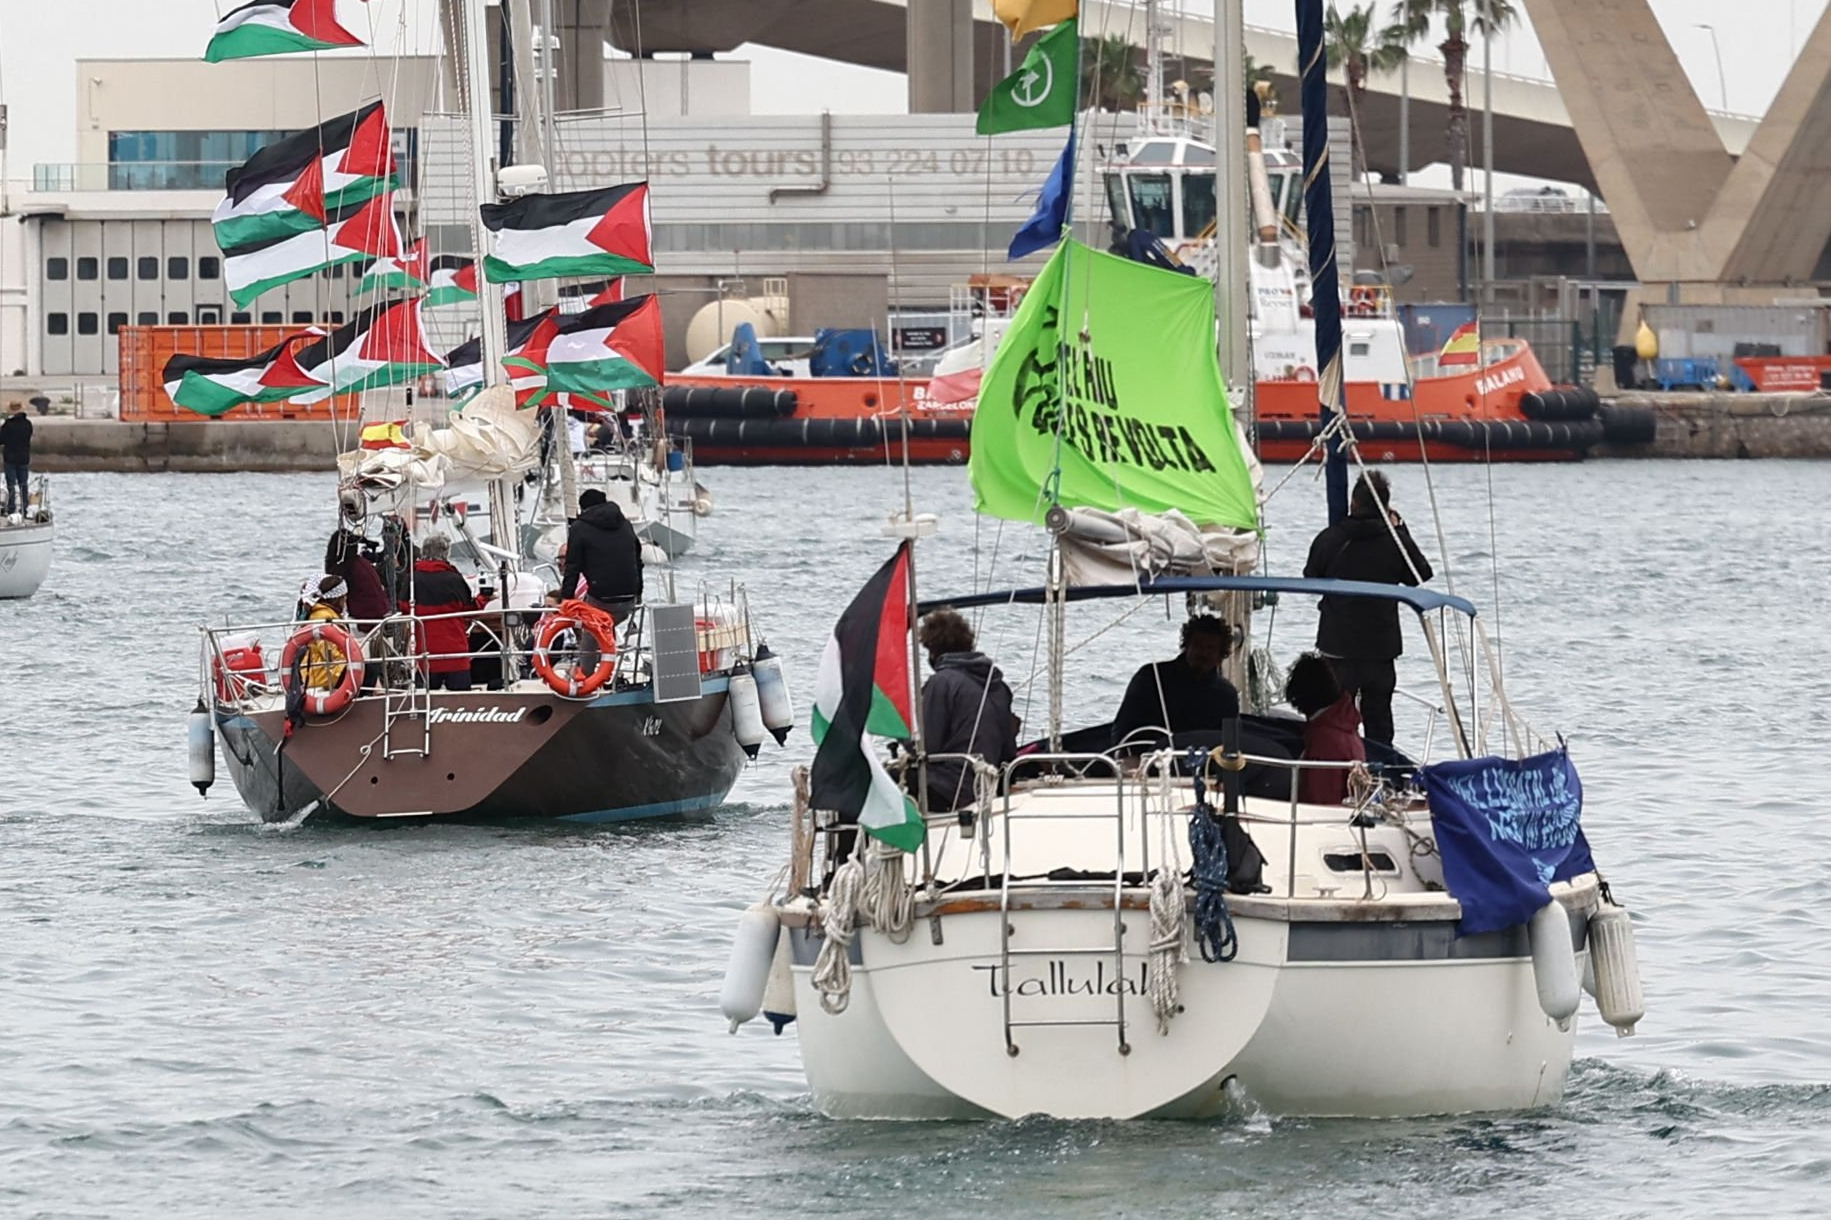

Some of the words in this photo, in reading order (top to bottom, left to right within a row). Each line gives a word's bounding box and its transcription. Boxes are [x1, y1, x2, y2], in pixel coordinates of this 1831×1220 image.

[705, 143, 817, 177] tours
[838, 149, 875, 176] 93
[885, 149, 939, 175] 224
[429, 706, 528, 724] Trinidad
